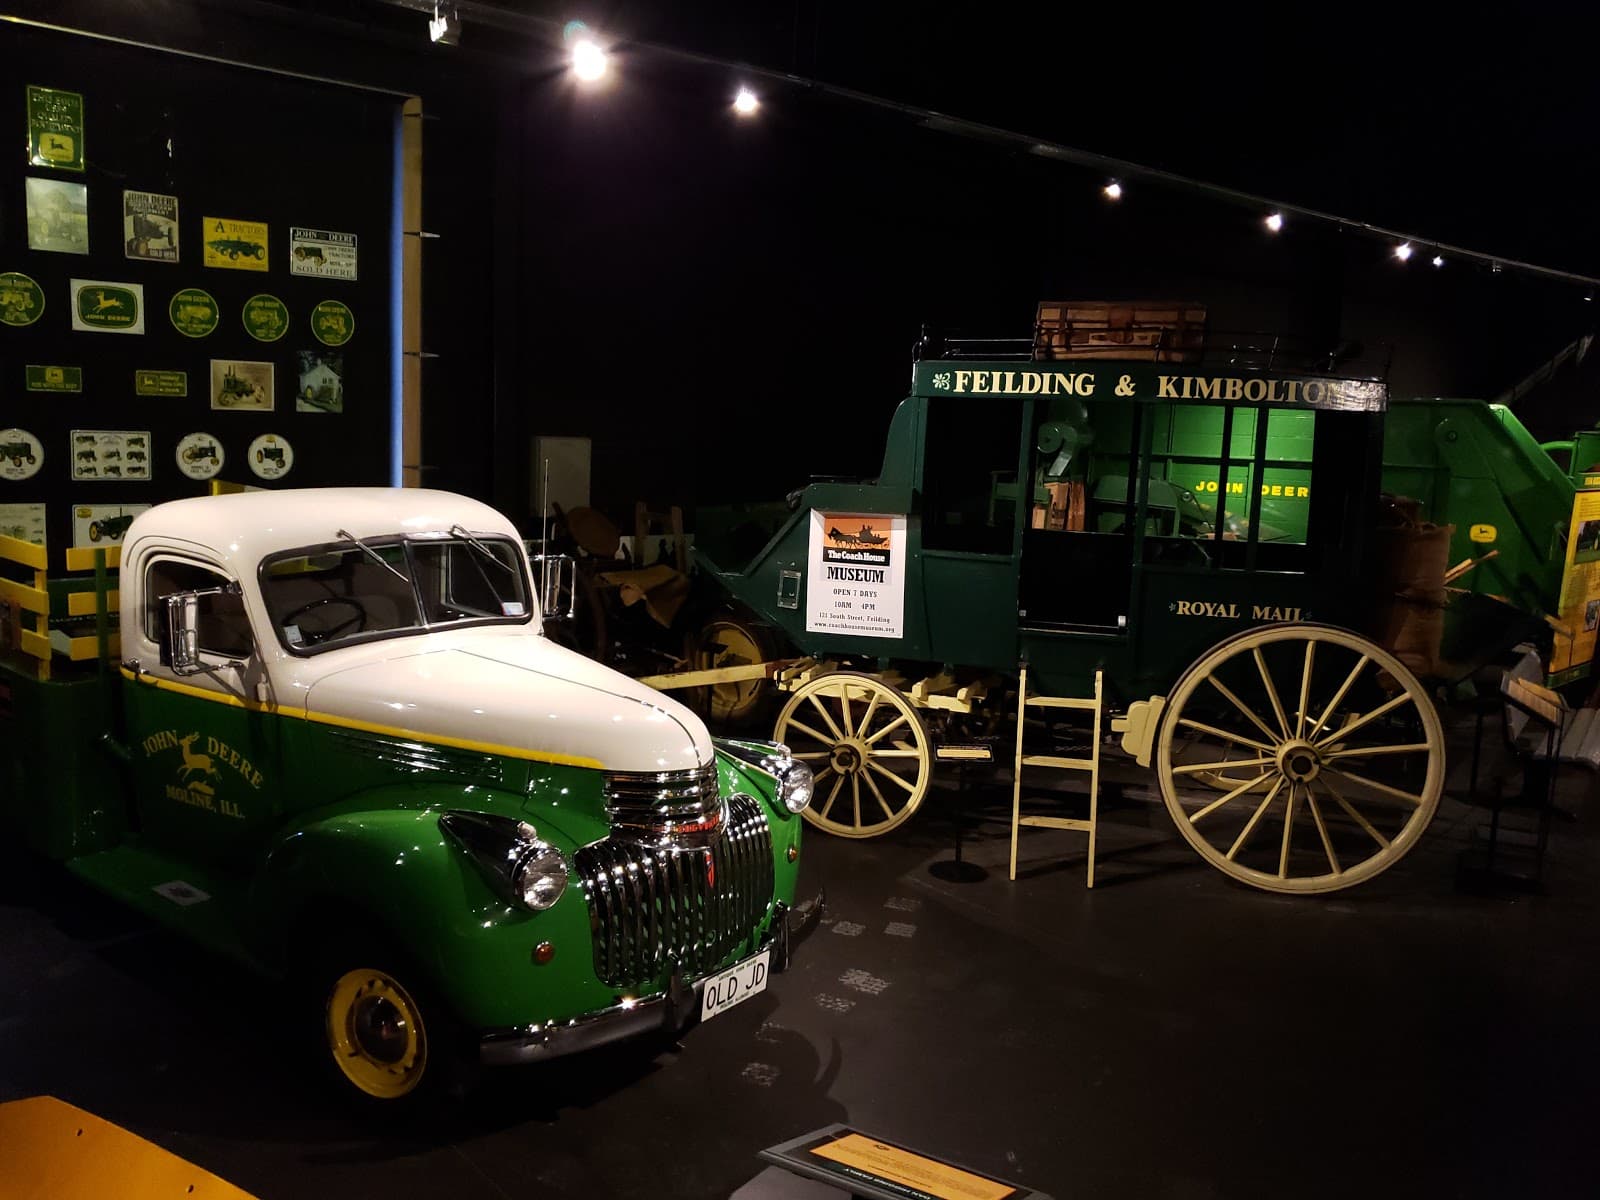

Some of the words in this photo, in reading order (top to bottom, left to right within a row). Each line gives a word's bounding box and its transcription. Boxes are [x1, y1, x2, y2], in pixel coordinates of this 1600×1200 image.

[215, 221, 225, 233] A
[294, 230, 318, 240] JOHN
[328, 234, 354, 244] DEERE
[295, 265, 323, 275] SOLD
[325, 268, 352, 277] HERE
[953, 370, 1096, 395] FEILDING
[1114, 374, 1136, 396] &
[1195, 481, 1243, 494] JON
[1261, 485, 1309, 498] DEER
[828, 550, 842, 559] The
[842, 551, 863, 561] Coach
[863, 552, 885, 562] House
[827, 567, 884, 583] MUSEUM
[833, 588, 851, 597] OPEN
[859, 590, 877, 598] DAYS
[834, 601, 852, 609] 10AM
[861, 602, 876, 611] 4PM
[1176, 600, 1241, 619] ROYAL
[1251, 605, 1305, 622] MAIL
[829, 612, 846, 620] South
[847, 613, 865, 622] Street,
[142, 729, 179, 758] JOHN
[207, 736, 264, 790] DEERE
[706, 976, 738, 1010] OLD
[745, 961, 766, 990] JD
